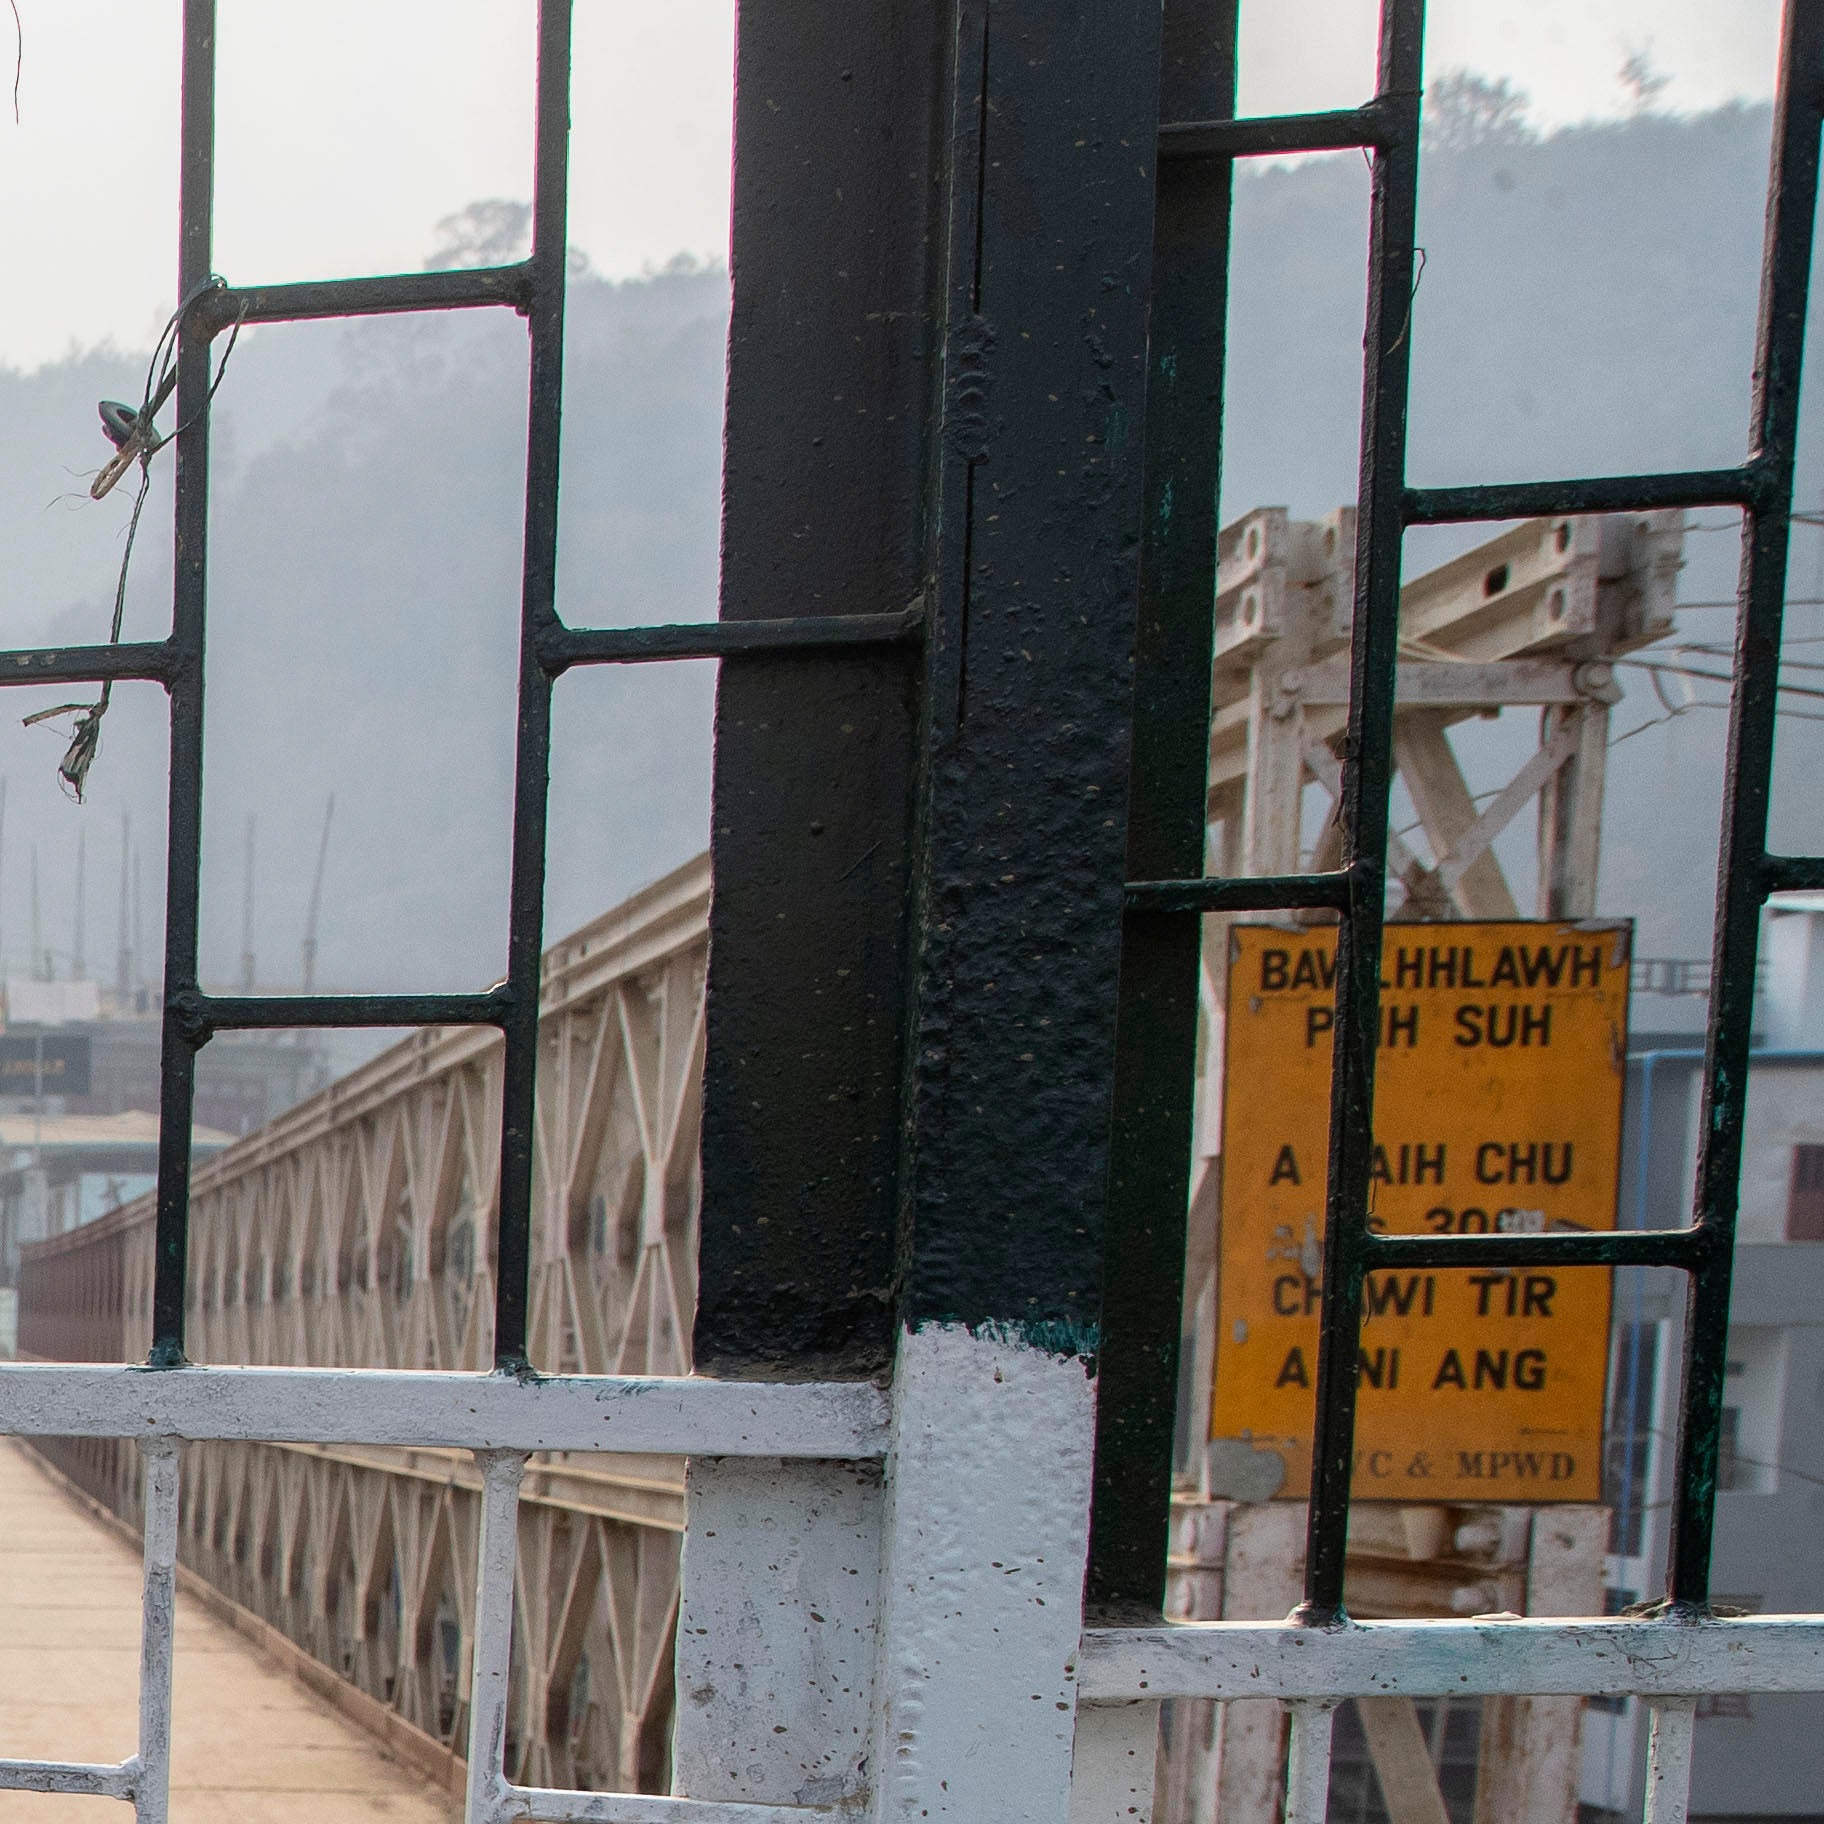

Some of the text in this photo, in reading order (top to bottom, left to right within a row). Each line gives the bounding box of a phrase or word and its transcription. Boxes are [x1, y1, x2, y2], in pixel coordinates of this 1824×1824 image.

[1260, 945, 1601, 991] BAHHLAWH
[1306, 1003, 1552, 1048] PIH SUH
[1268, 1141, 1574, 1187] A AIH CHU
[1272, 1274, 1557, 1318] CHWI TIR
[1275, 1347, 1309, 1390] A
[1432, 1347, 1547, 1391] ANG
[1406, 1451, 1433, 1479] &
[1455, 1450, 1575, 1481] MPWD
